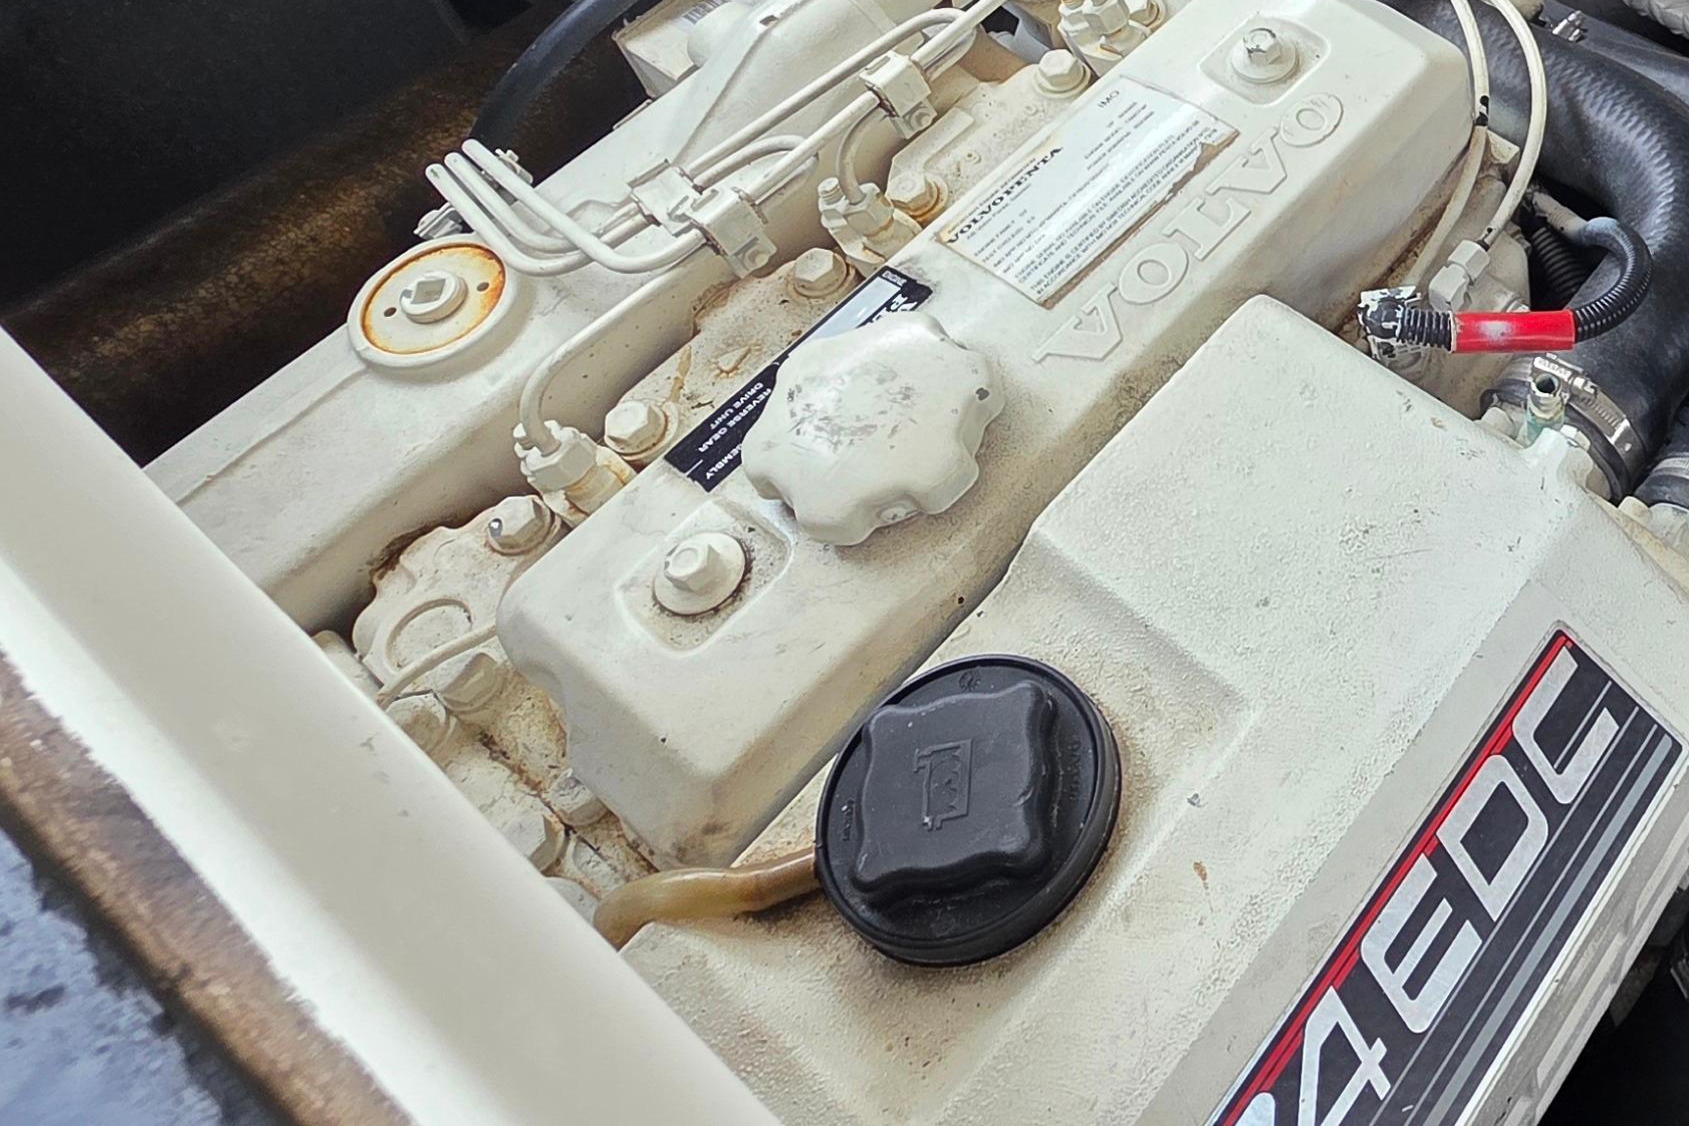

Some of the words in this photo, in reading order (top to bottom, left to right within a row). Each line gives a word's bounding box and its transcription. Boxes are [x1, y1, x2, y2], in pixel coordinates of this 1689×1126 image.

[1097, 88, 1121, 110] IMO
[945, 193, 1005, 248] VOLVO
[1003, 142, 1063, 198] PENTA
[1032, 93, 1344, 362] VOLVO
[727, 388, 772, 428] REVERSE
[733, 382, 764, 409] DRIVE
[710, 408, 734, 430] UNIT
[698, 427, 728, 453] GEAR
[706, 443, 742, 480] EMBLY
[1236, 646, 1620, 1126] 4EDC
